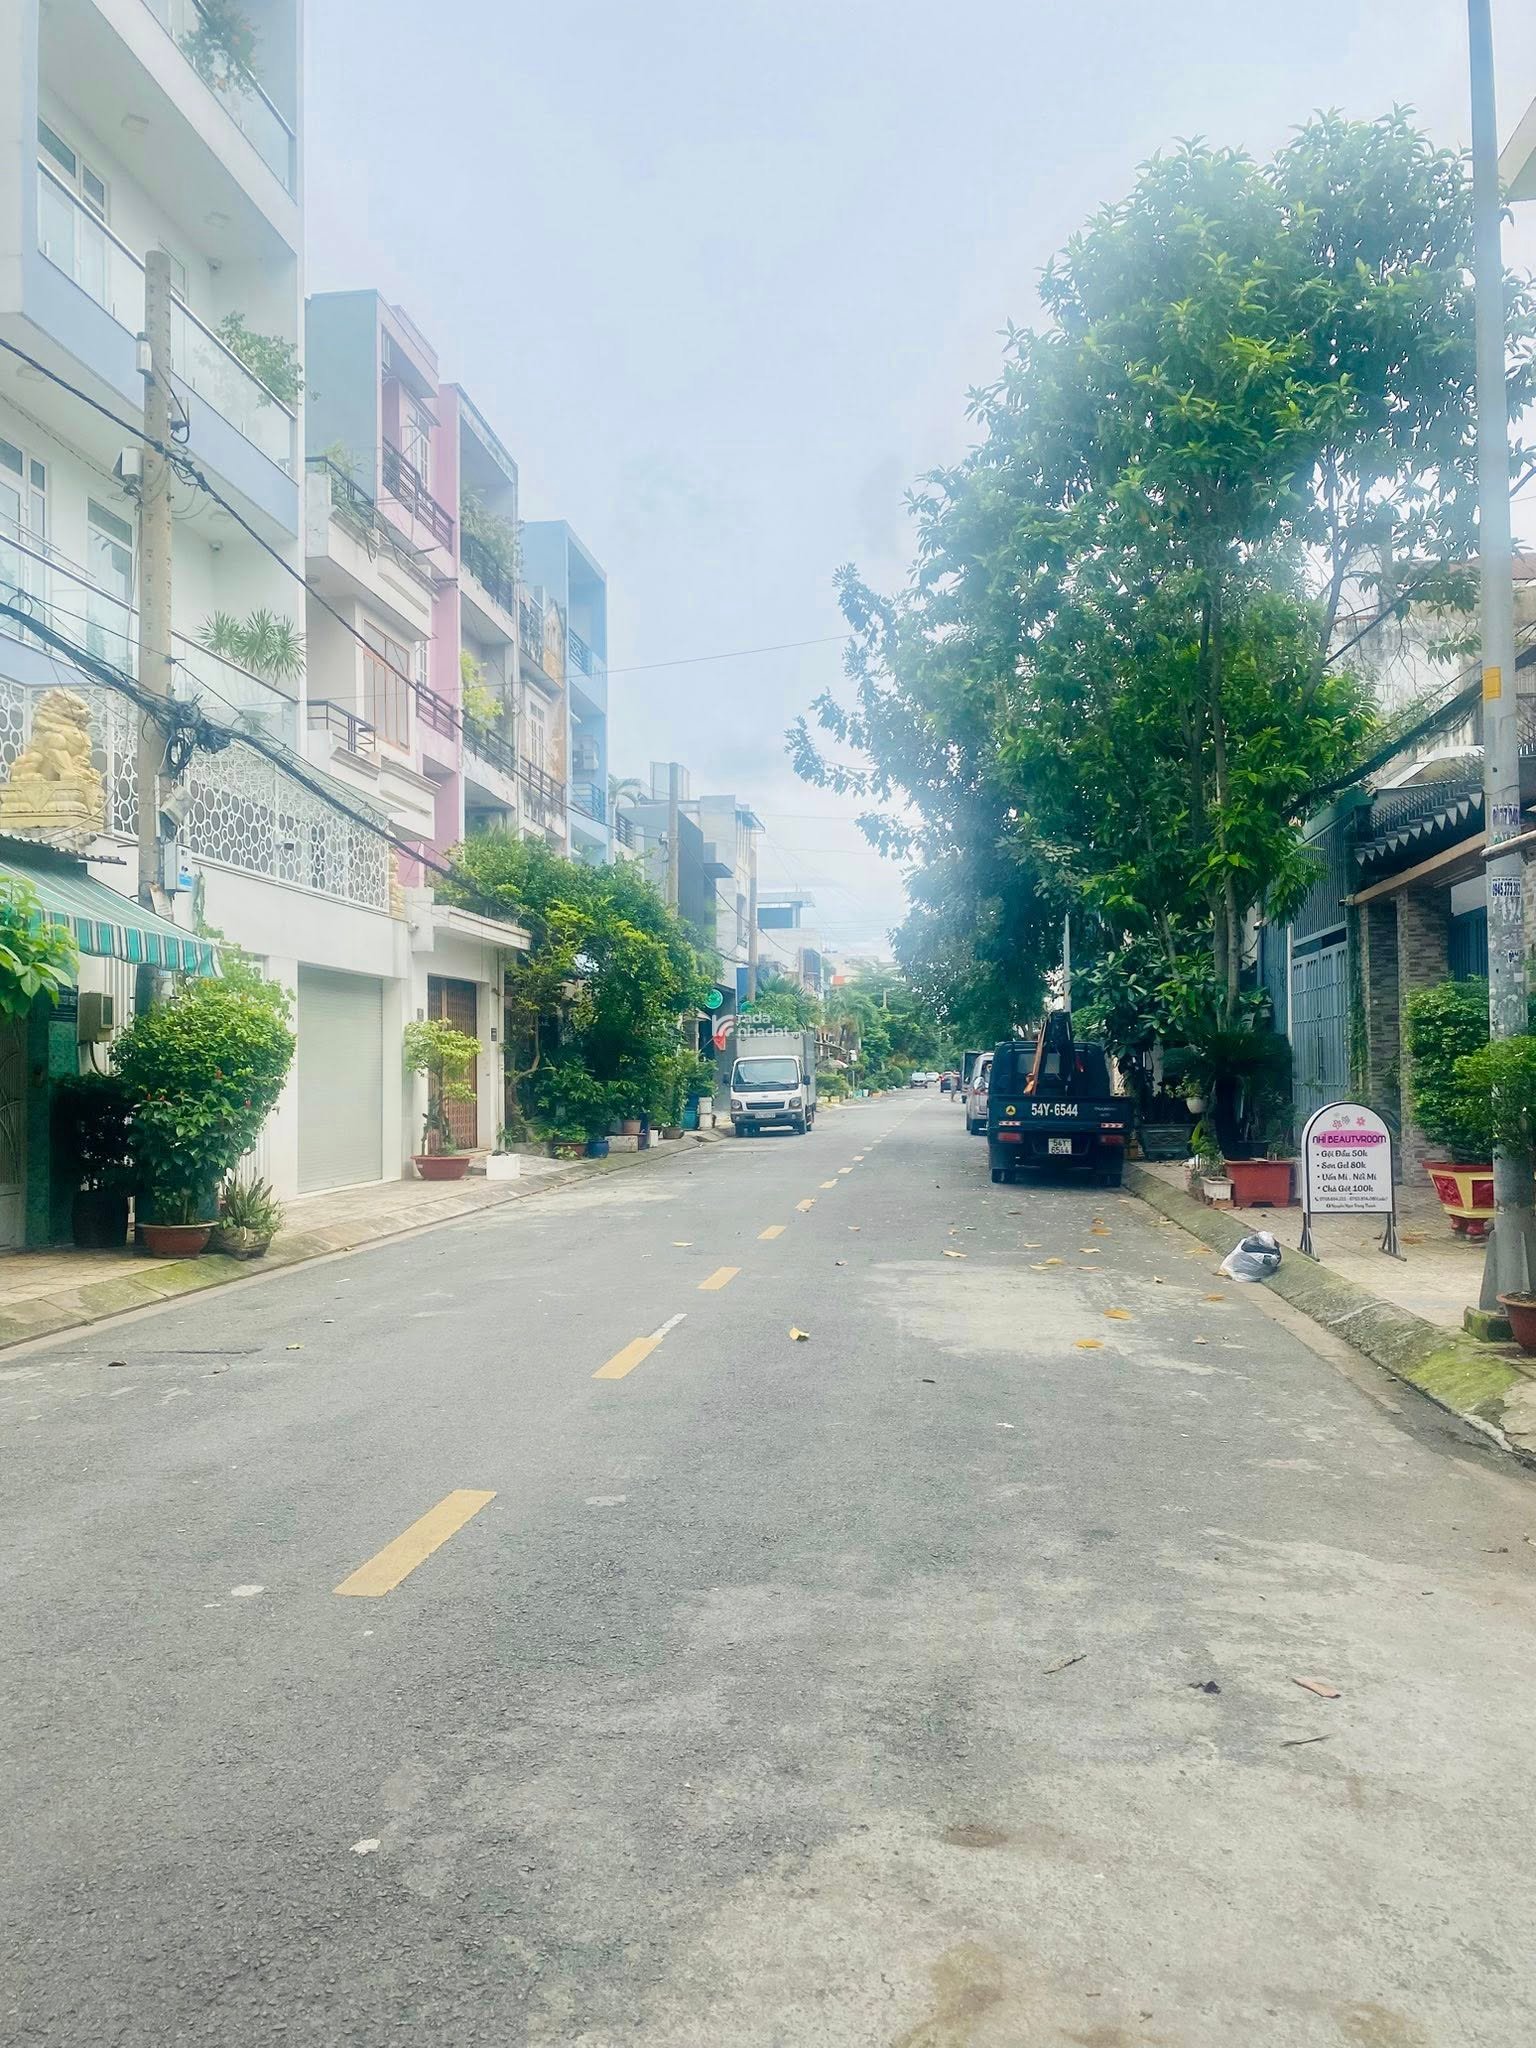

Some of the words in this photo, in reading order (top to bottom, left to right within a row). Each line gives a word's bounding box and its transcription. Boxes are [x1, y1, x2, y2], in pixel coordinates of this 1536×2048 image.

[1031, 1103, 1078, 1117] 54Y-6544
[1351, 1149, 1368, 1157] 50k
[1350, 1161, 1367, 1169] 80k
[1352, 1184, 1374, 1192] 100k
